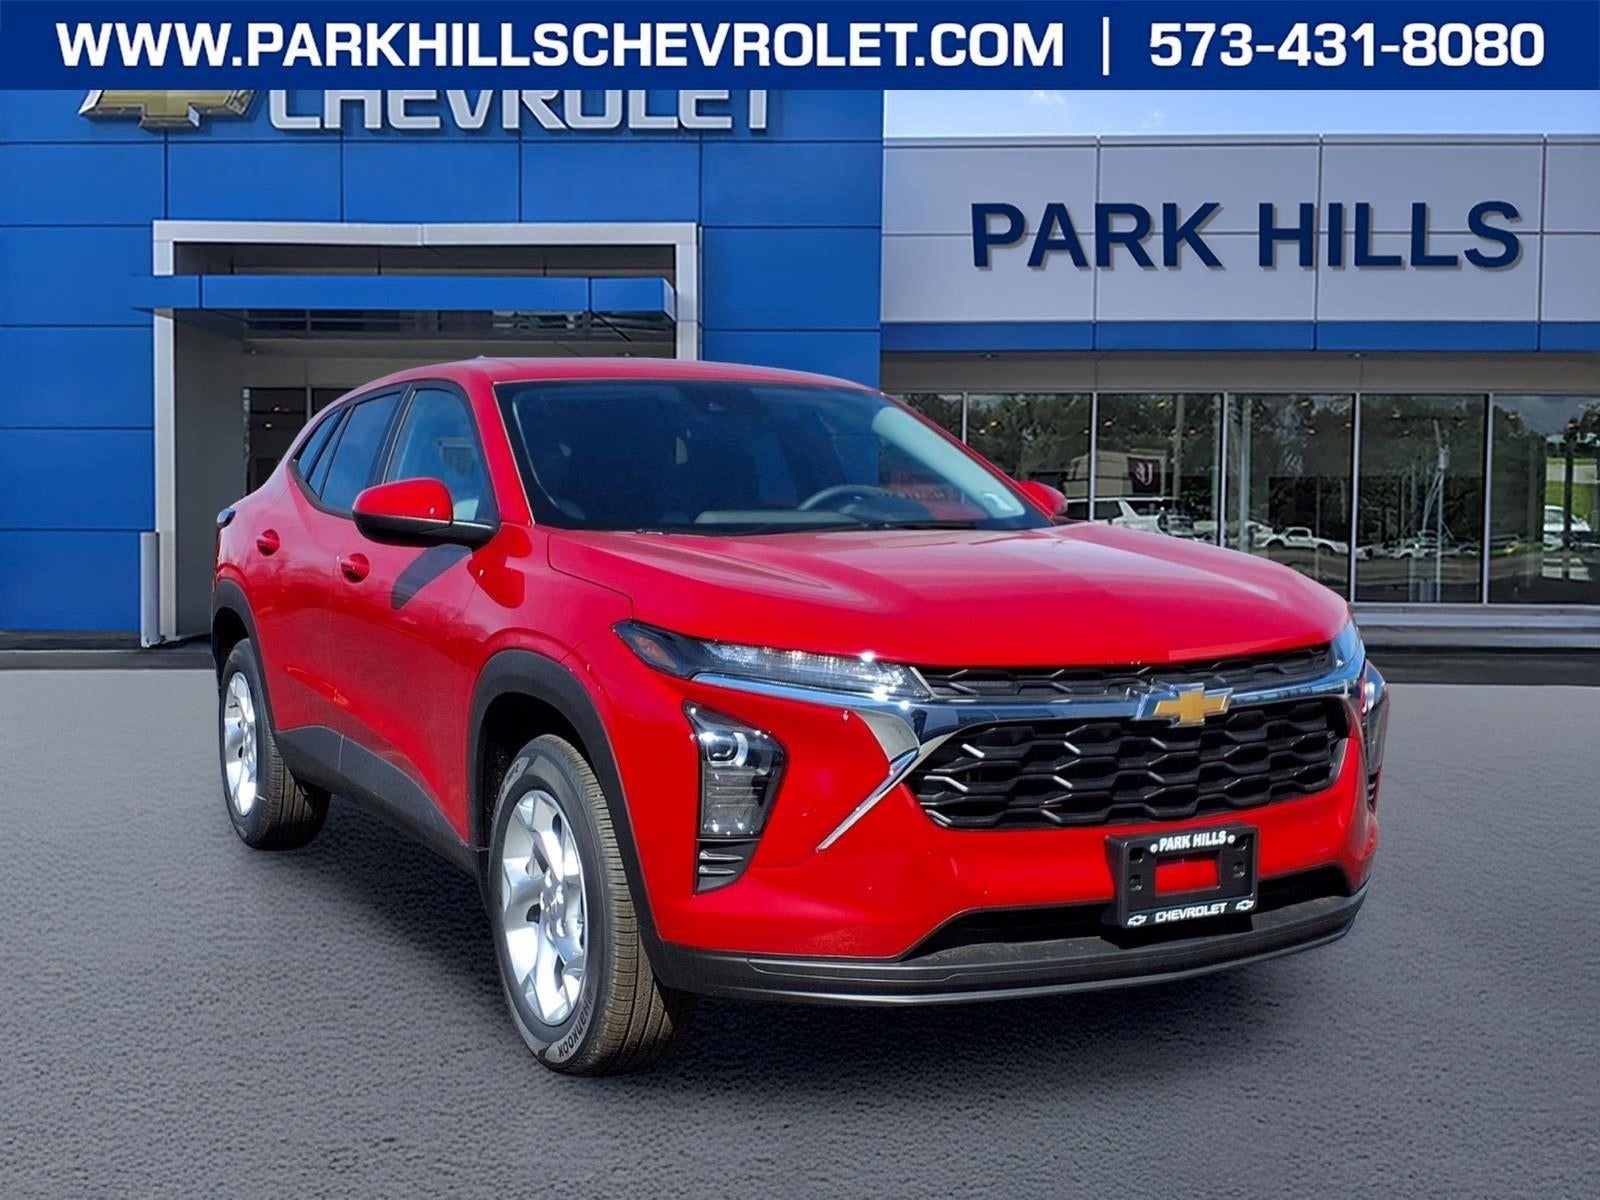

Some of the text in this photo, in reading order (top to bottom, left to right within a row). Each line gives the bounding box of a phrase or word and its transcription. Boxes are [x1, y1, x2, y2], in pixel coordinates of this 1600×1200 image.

[971, 201, 1522, 269] PARK HILLS
[1159, 831, 1227, 852] PARK HILLS
[1155, 903, 1227, 922] CHEVROLET
